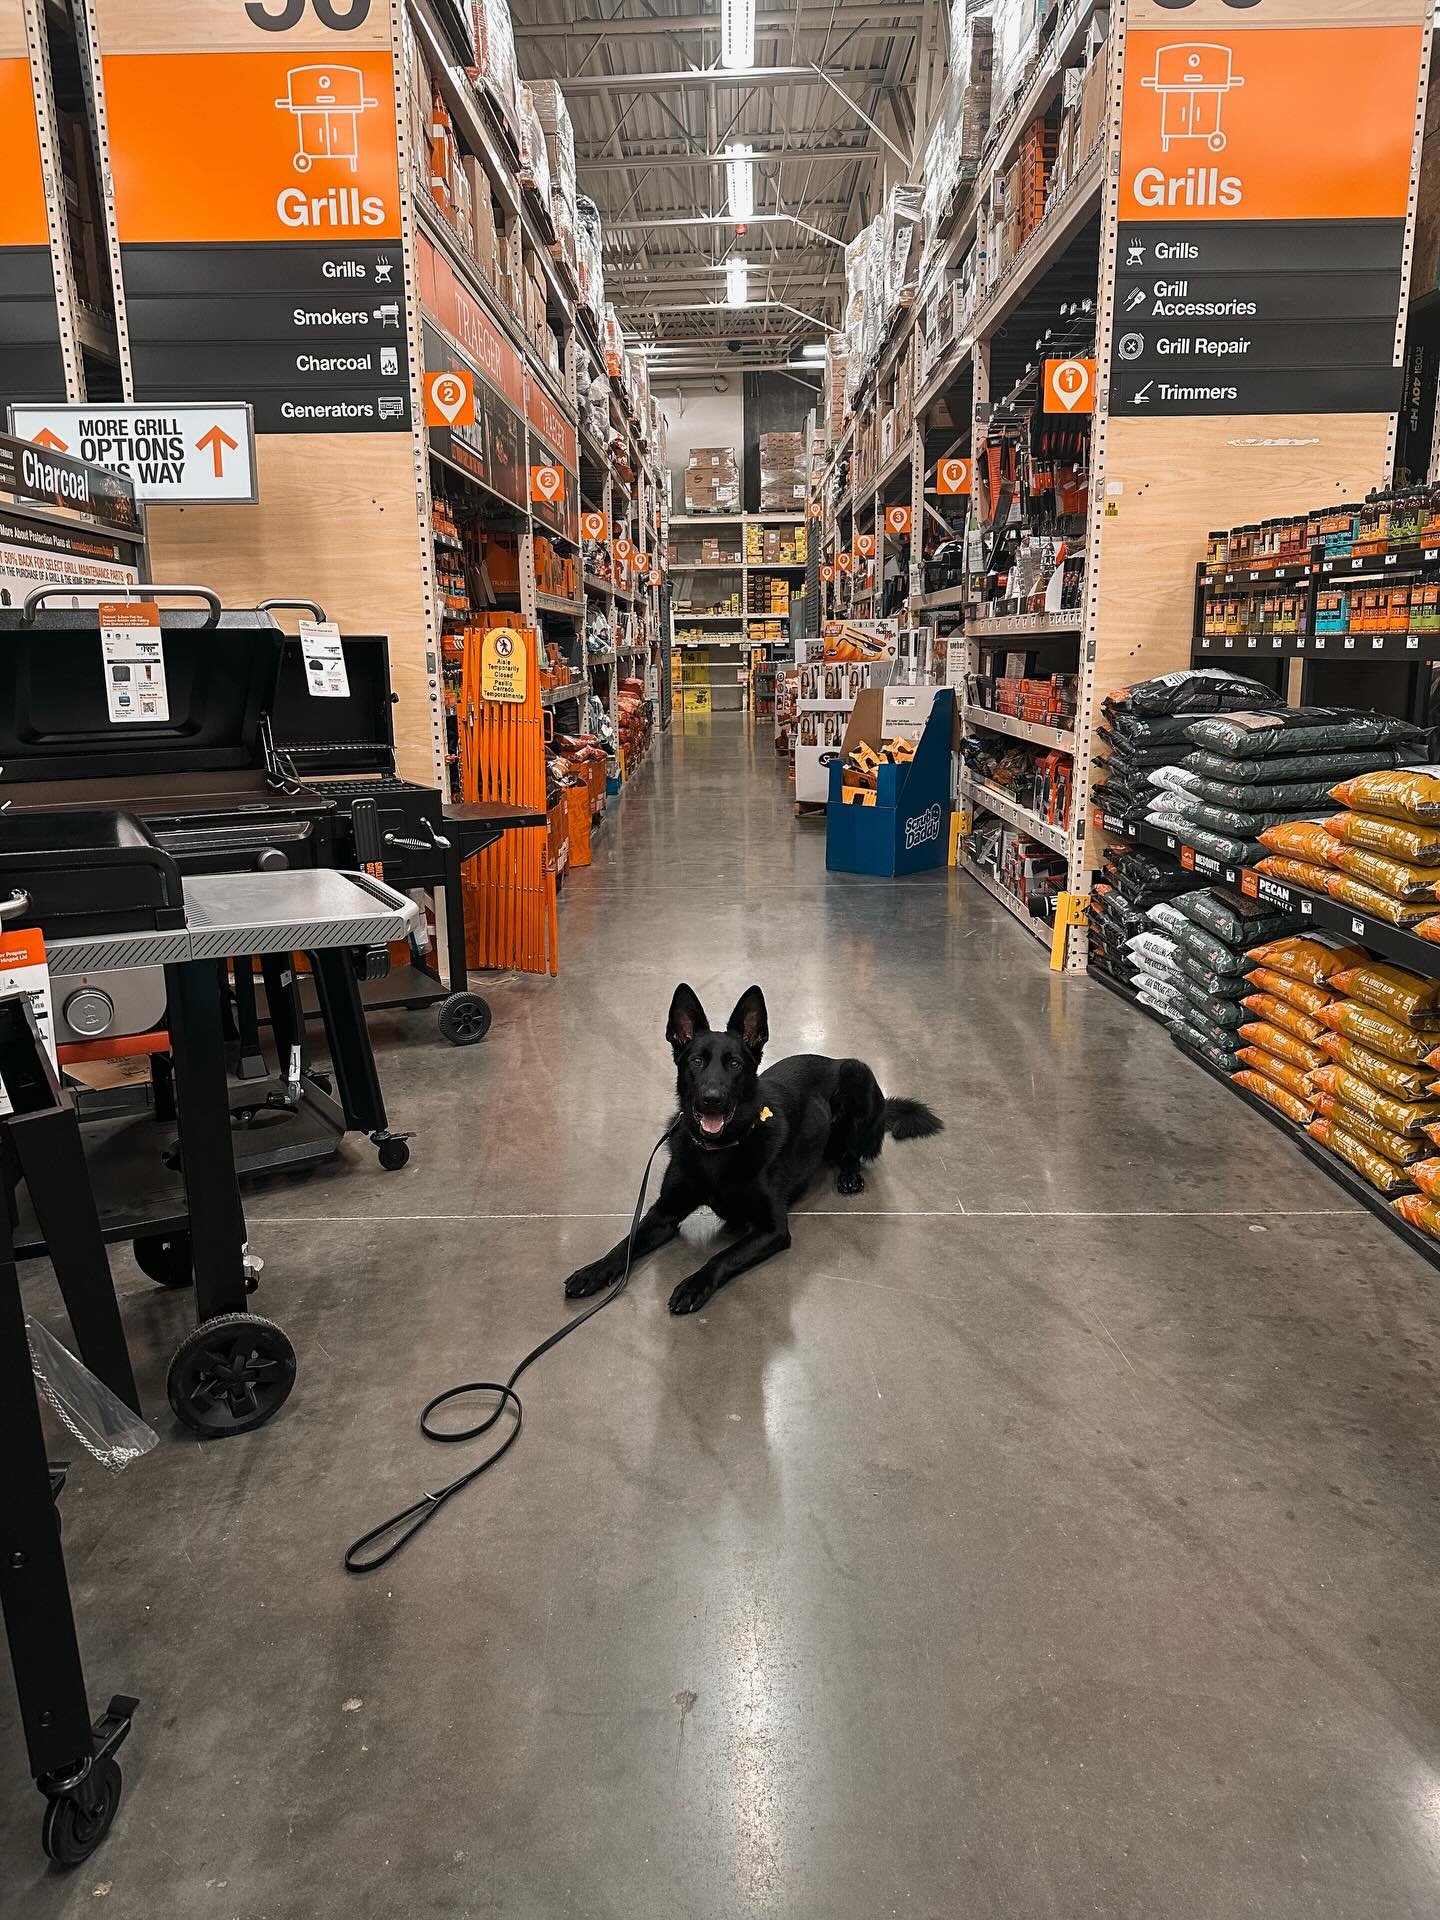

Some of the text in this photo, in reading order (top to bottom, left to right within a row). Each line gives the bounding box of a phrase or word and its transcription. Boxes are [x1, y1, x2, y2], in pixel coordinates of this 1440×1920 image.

[1133, 167, 1242, 206] Grills
[276, 188, 386, 227] Grills
[1154, 242, 1199, 260] Grills
[322, 261, 366, 279] Grills
[1153, 281, 1187, 297] Grill
[1152, 299, 1257, 317] Accessories
[293, 309, 369, 326] Smokers
[455, 291, 502, 382] TRAEGER
[1156, 338, 1251, 358] Grill Repair
[296, 355, 371, 373] Charcoal
[1066, 375, 1073, 389] 1
[443, 388, 455, 402] 2
[1158, 385, 1238, 400] Trimmers
[281, 402, 374, 420] Generators
[79, 418, 184, 437] MORE GRILL
[541, 400, 565, 451] TRAEGER
[80, 437, 185, 462] OPTIONS
[22, 449, 90, 503] Charcoal
[137, 462, 185, 484] WAY
[544, 476, 552, 486] 2
[951, 469, 958, 479] 1
[18, 553, 34, 568] BACK
[34, 556, 45, 570] FOR
[45, 558, 63, 572] SELECT
[64, 561, 78, 575] GRILL
[78, 564, 110, 579] MAINTENANCE
[488, 664, 520, 672] Temporarily
[484, 690, 524, 699] Temporalmente
[905, 809, 932, 833] Scrub
[906, 819, 940, 849] Daddy
[1195, 853, 1220, 872] MESQUITE
[1259, 878, 1289, 901] PECAN
